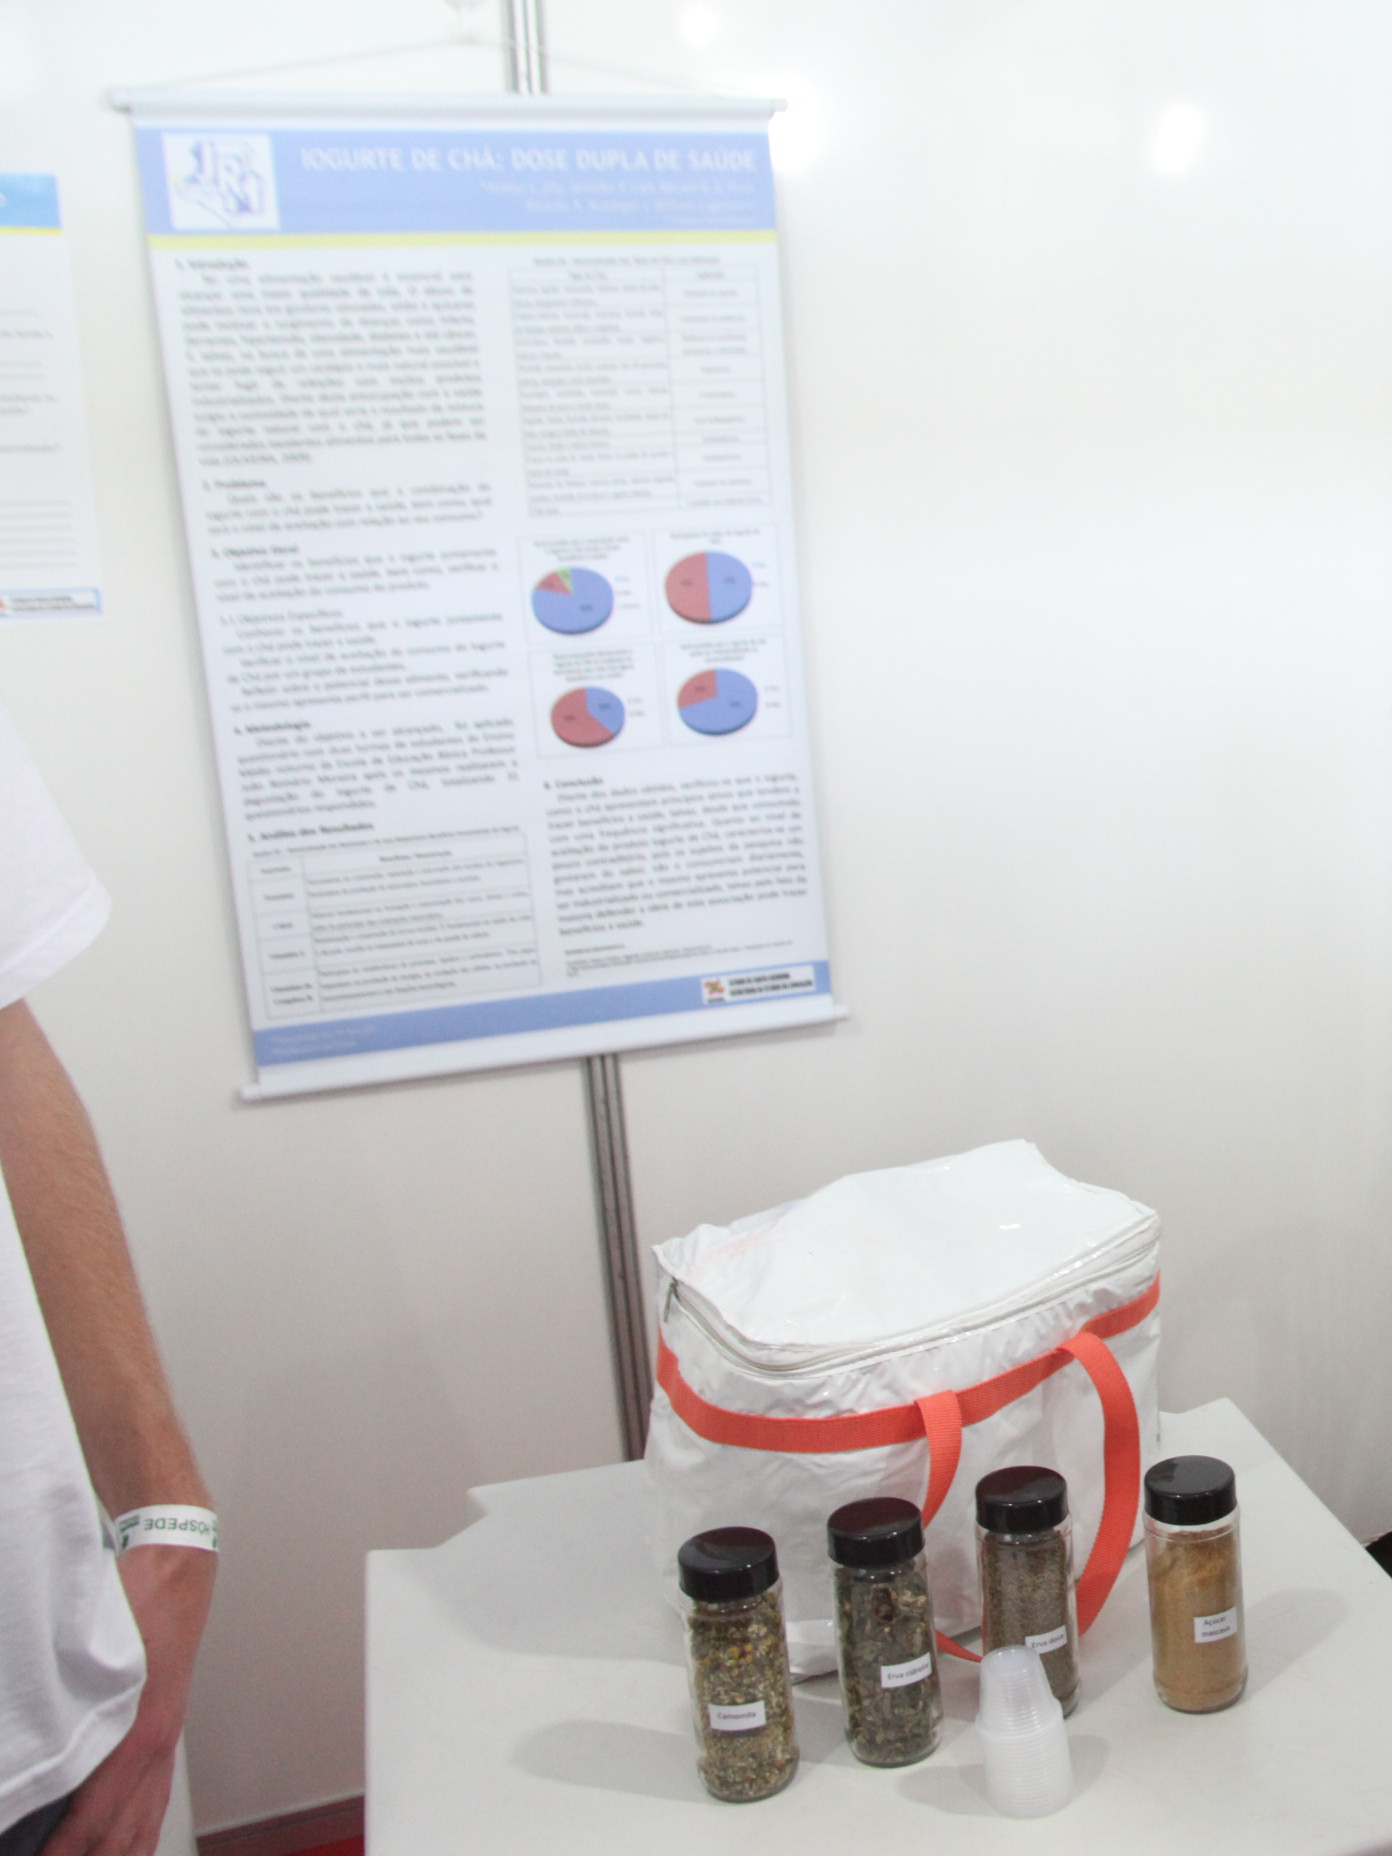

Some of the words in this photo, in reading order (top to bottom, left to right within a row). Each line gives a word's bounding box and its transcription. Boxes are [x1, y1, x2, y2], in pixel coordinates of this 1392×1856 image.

[301, 147, 405, 171] IOGURTE
[411, 147, 442, 171] DE
[448, 143, 504, 171] CHÁ:
[510, 148, 568, 171] DOSE
[575, 148, 650, 171] DUPLA
[653, 148, 683, 171] DE
[687, 143, 757, 172] SAÚDE
